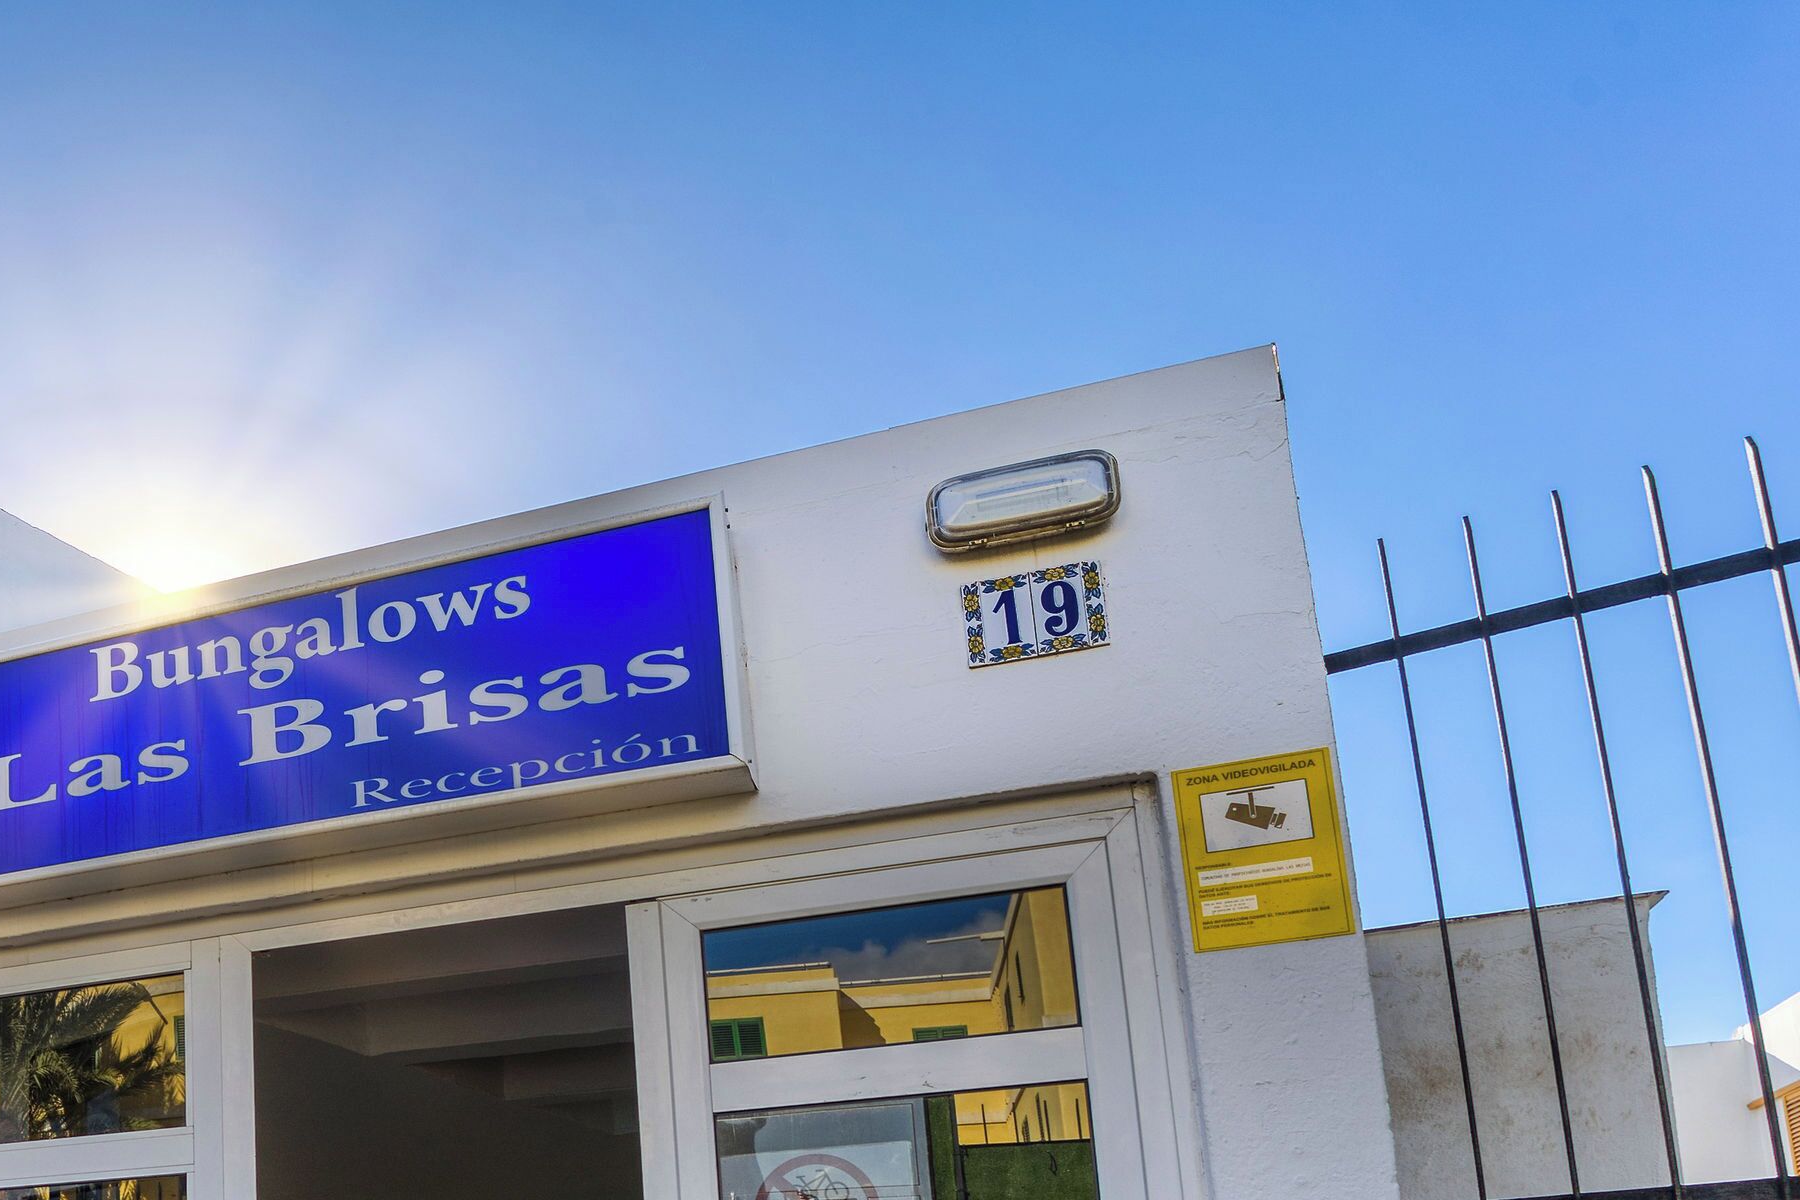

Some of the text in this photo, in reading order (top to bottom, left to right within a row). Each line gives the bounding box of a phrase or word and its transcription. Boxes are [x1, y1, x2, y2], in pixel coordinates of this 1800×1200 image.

[88, 575, 532, 702] Bungalows
[992, 580, 1080, 645] 19
[237, 645, 692, 767] Brisas
[348, 731, 705, 809] Recepción
[1185, 758, 1316, 786] ZONA VIDEOVIGILADA
